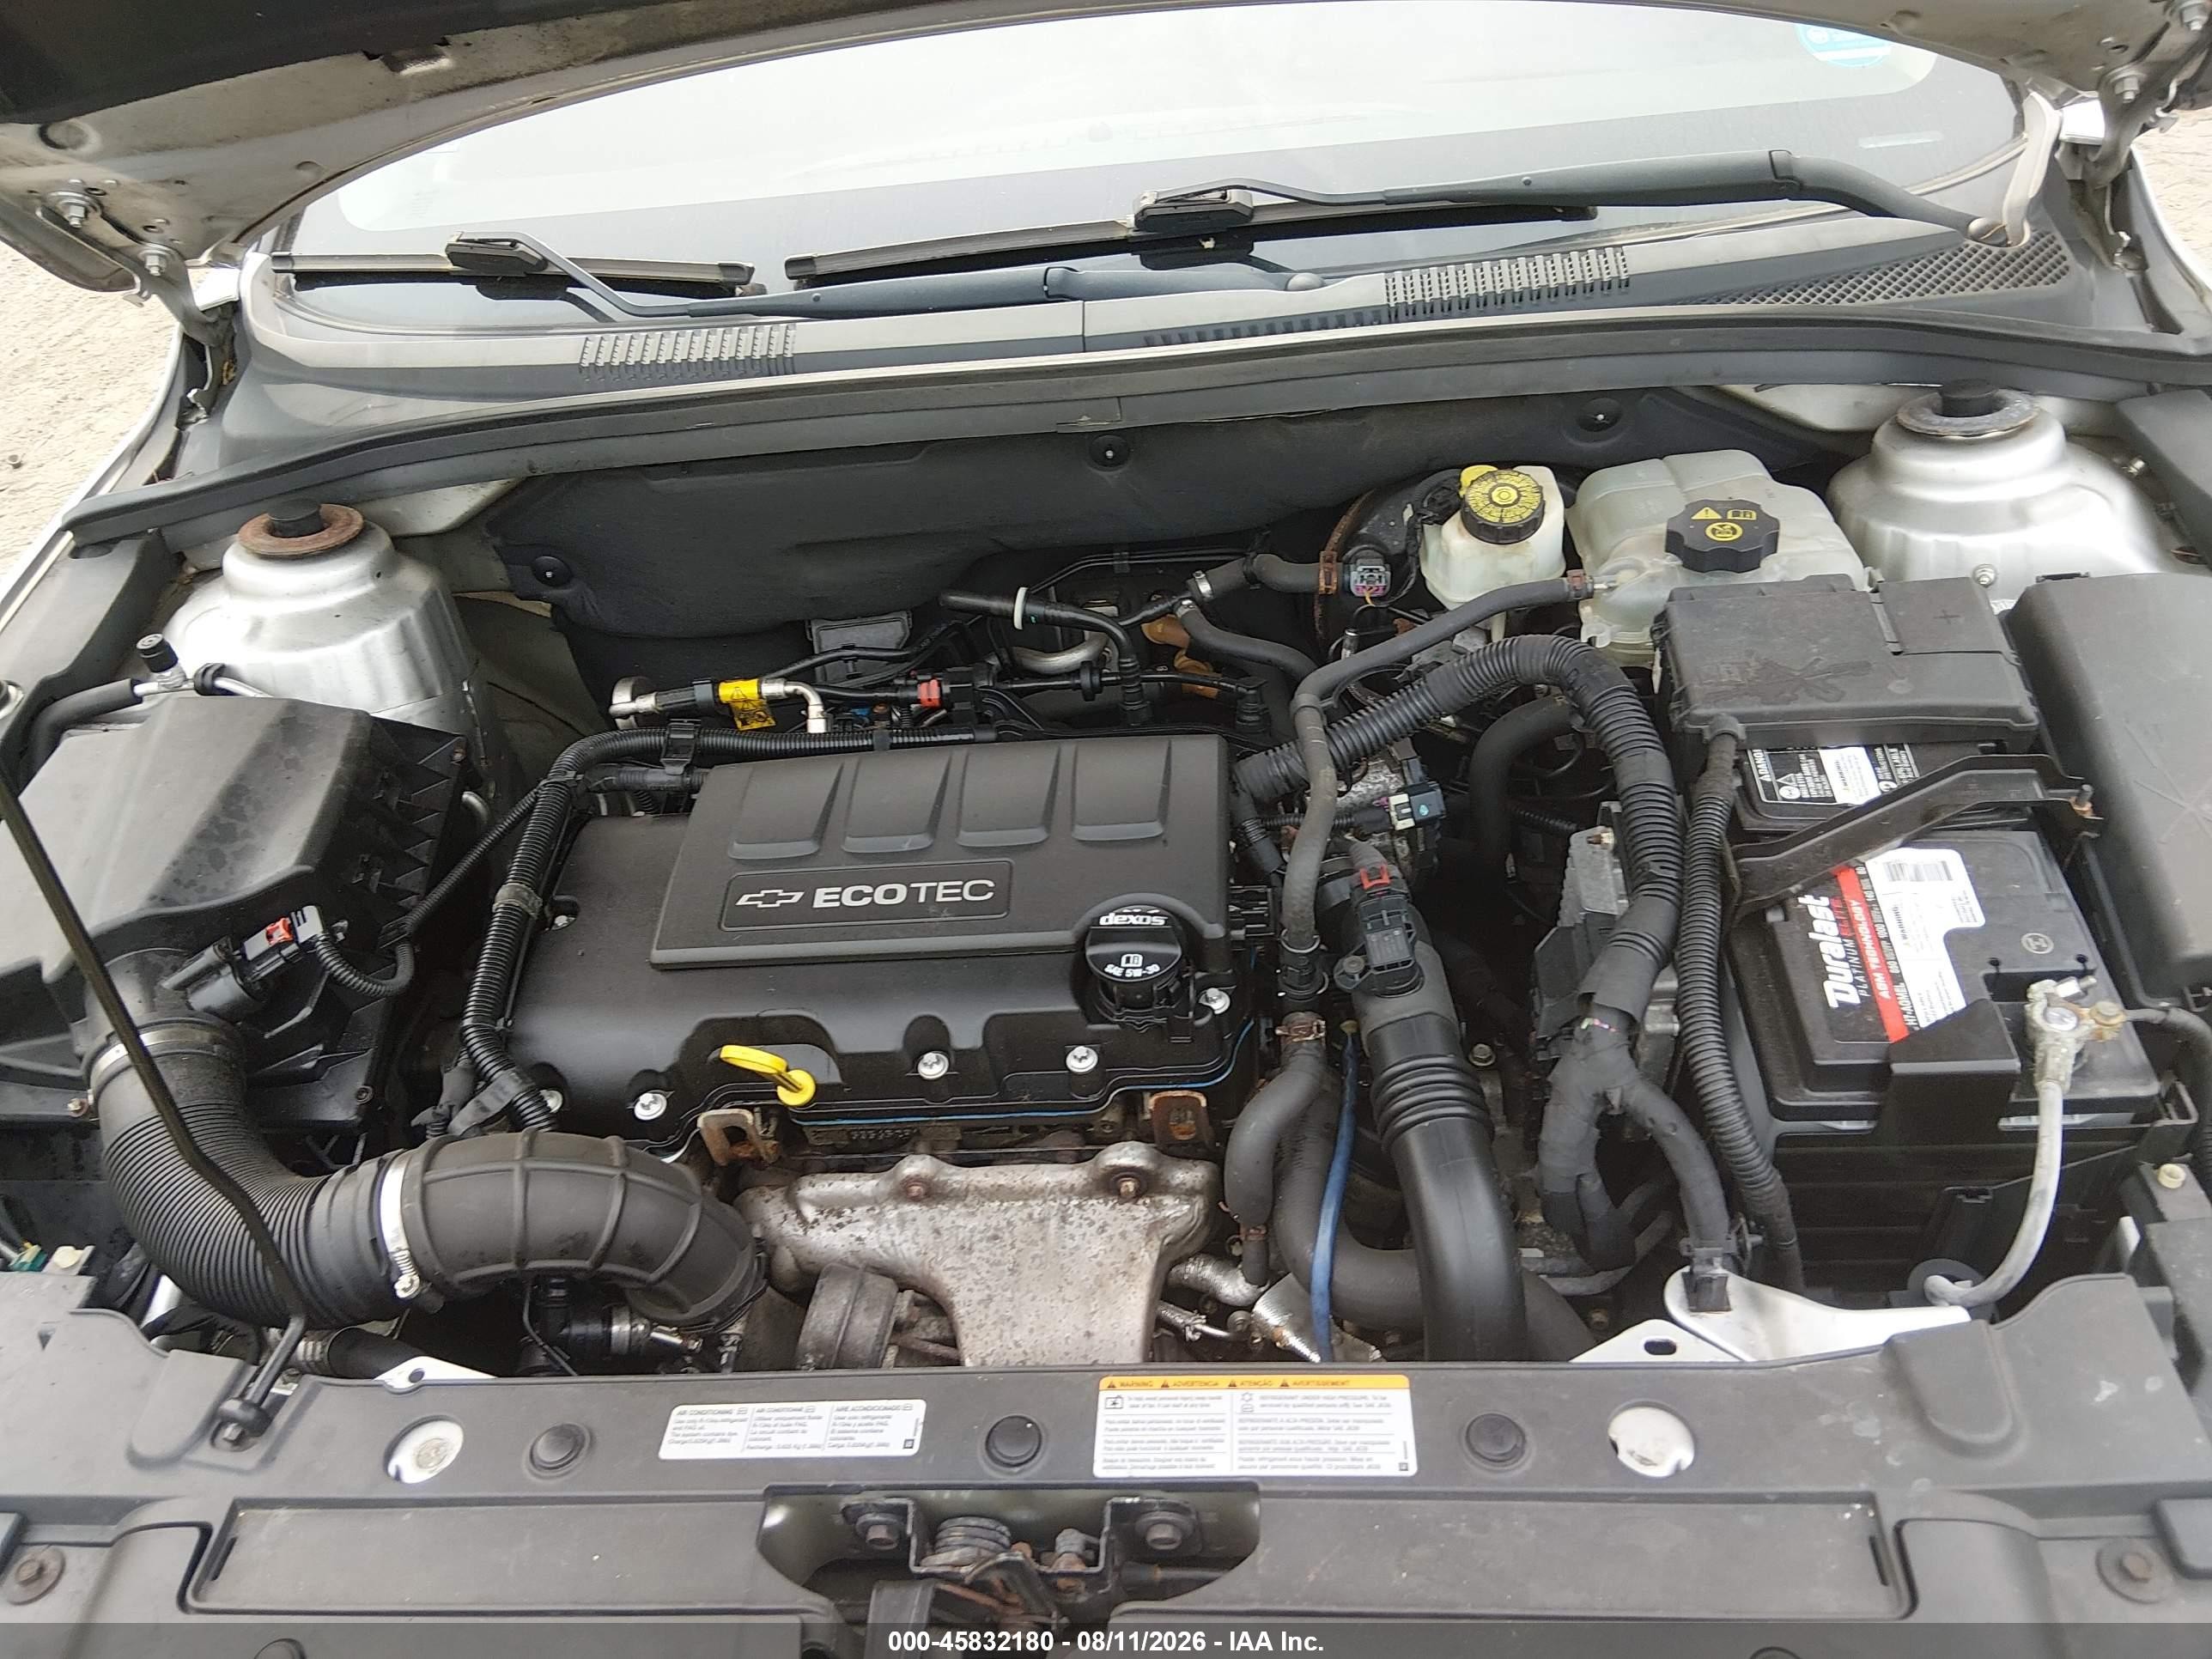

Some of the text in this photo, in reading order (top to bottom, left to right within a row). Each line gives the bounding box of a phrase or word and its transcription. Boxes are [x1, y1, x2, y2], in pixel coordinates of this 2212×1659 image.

[812, 879, 995, 908] ECOTEC
[1100, 913, 1168, 925] dexos
[1850, 899, 1881, 969] TECHNOLOGY
[1797, 895, 1861, 1008] Duralast
[1104, 964, 1159, 977] SAE 5W-30
[1844, 939, 1870, 996] PLATINUM
[1873, 972, 1892, 1000] AGM
